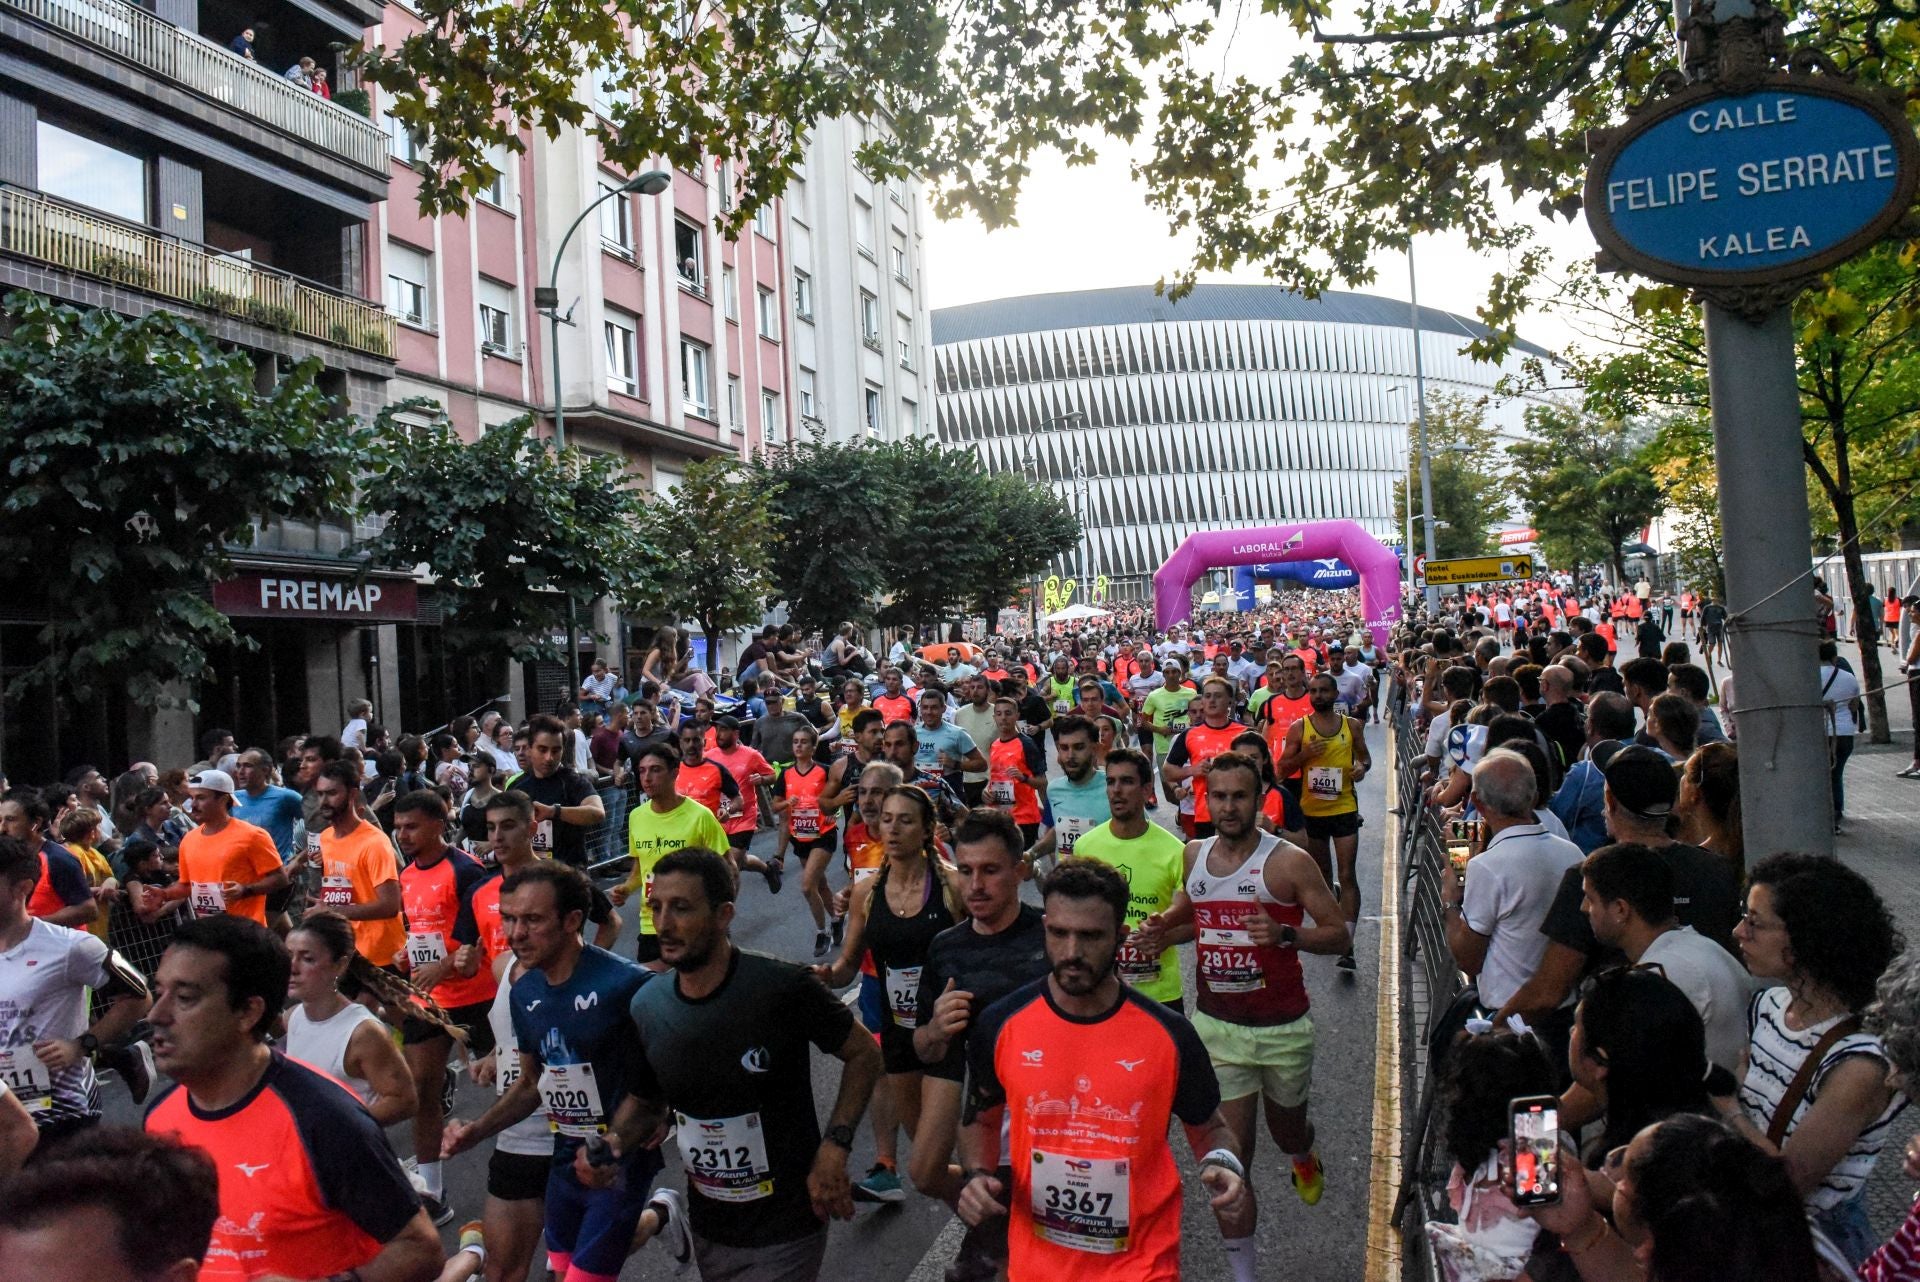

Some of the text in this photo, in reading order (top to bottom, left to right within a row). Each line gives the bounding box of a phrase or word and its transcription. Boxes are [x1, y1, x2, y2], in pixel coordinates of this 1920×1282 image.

[1689, 99, 1796, 133] CALLE
[1608, 145, 1895, 213] FELIPE SERRATE
[1699, 226, 1811, 259] KALEA
[1232, 542, 1281, 555] LABORAL
[1379, 538, 1404, 547] OLD
[1426, 565, 1449, 573] Hotel
[1451, 571, 1498, 580] Euskalduna
[260, 578, 382, 612] FREMAP
[551, 635, 568, 645] REMA
[1312, 777, 1336, 788] 3401
[793, 819, 818, 827] 20976
[531, 833, 547, 843] 83
[1238, 885, 1256, 893] MC
[323, 891, 352, 903] 20859
[411, 948, 441, 962] 1074
[1202, 950, 1258, 969] 28124
[546, 1090, 589, 1108] 2020
[689, 1146, 752, 1169] 2312
[1044, 1185, 1114, 1216] 3367
